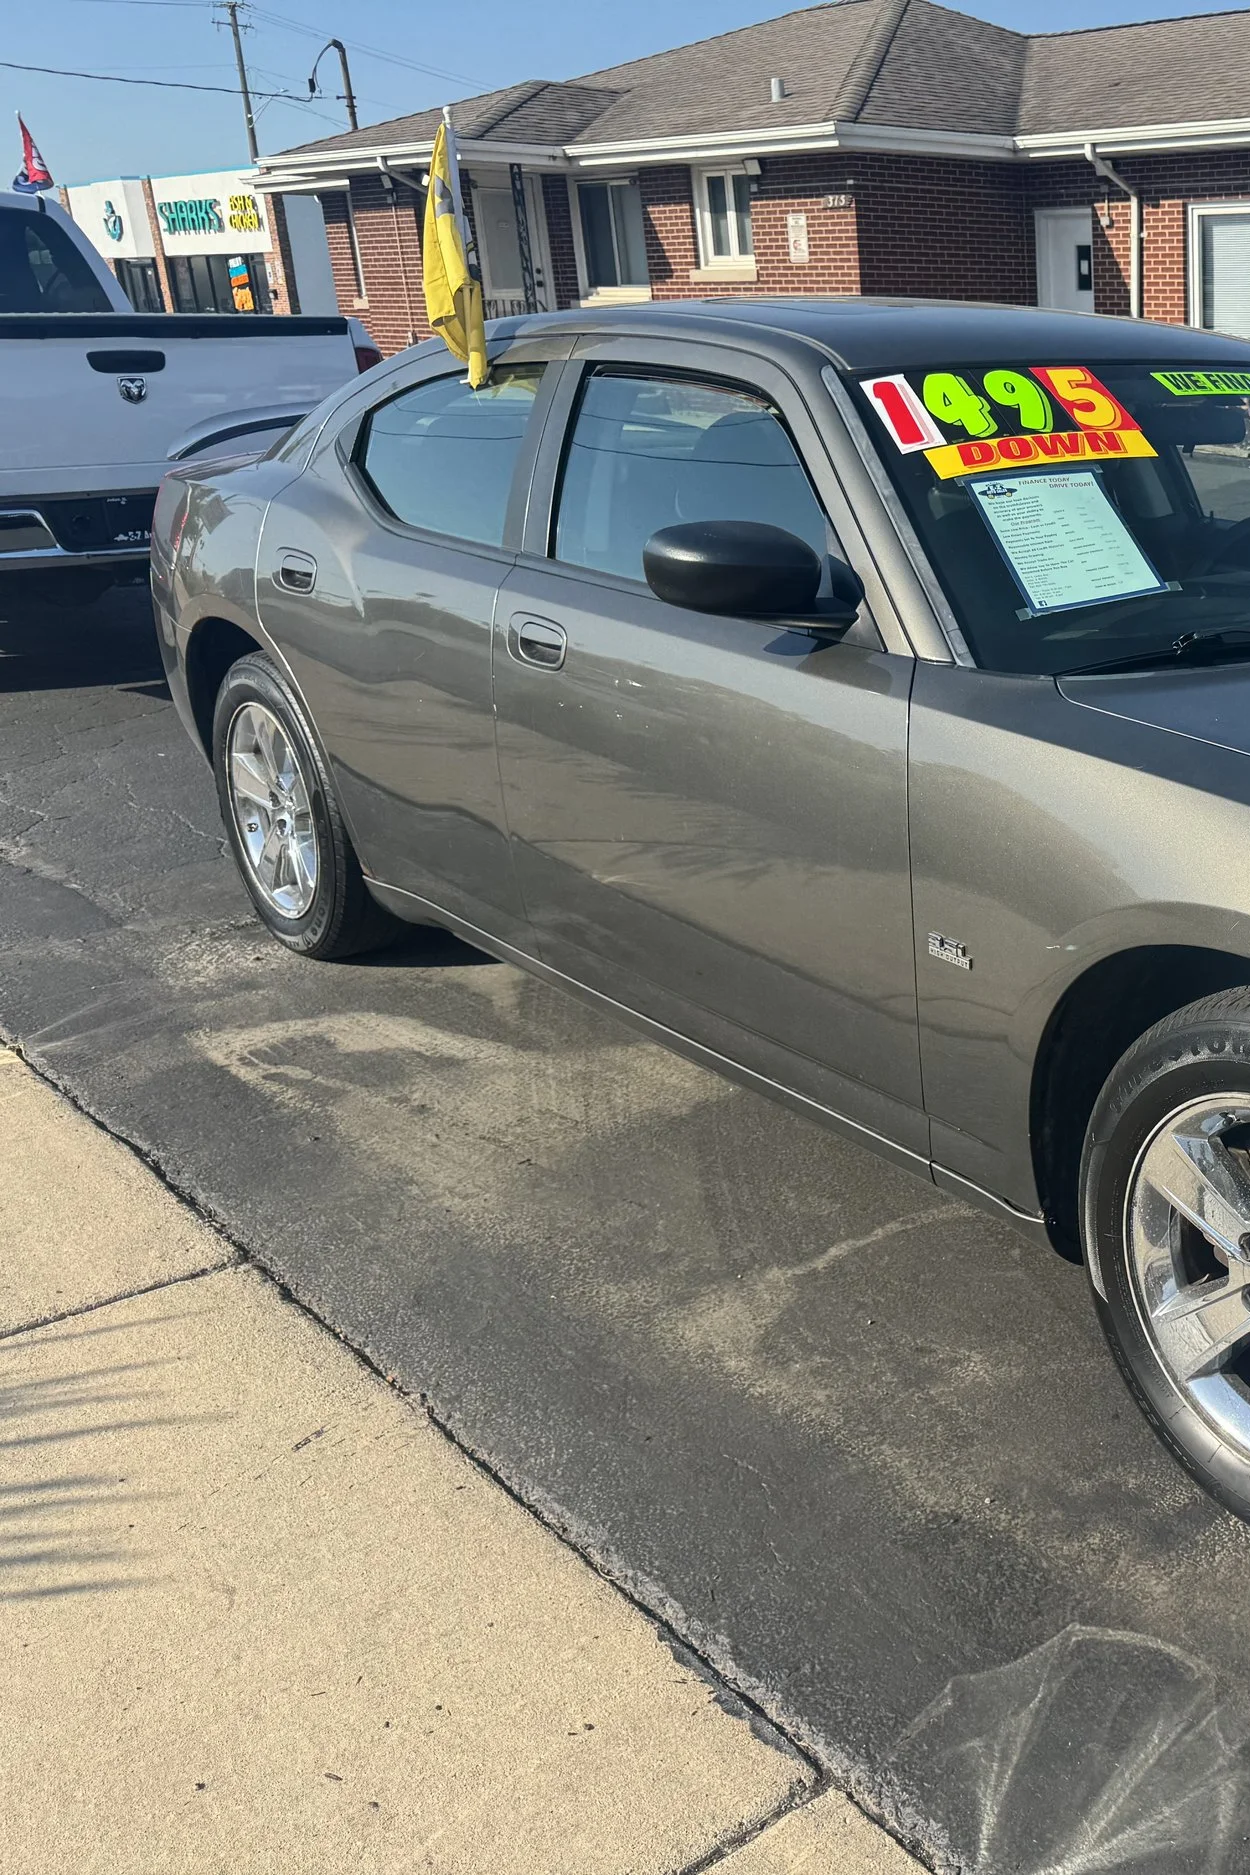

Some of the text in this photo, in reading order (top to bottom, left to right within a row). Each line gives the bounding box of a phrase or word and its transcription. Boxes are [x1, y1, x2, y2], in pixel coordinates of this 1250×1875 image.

[158, 199, 219, 233] SHARKS
[229, 213, 259, 230] CHICKEN
[1161, 374, 1207, 392] WE
[872, 368, 1122, 445] 1495
[956, 430, 1128, 468] DOWN
[1018, 478, 1047, 486] FINANCE
